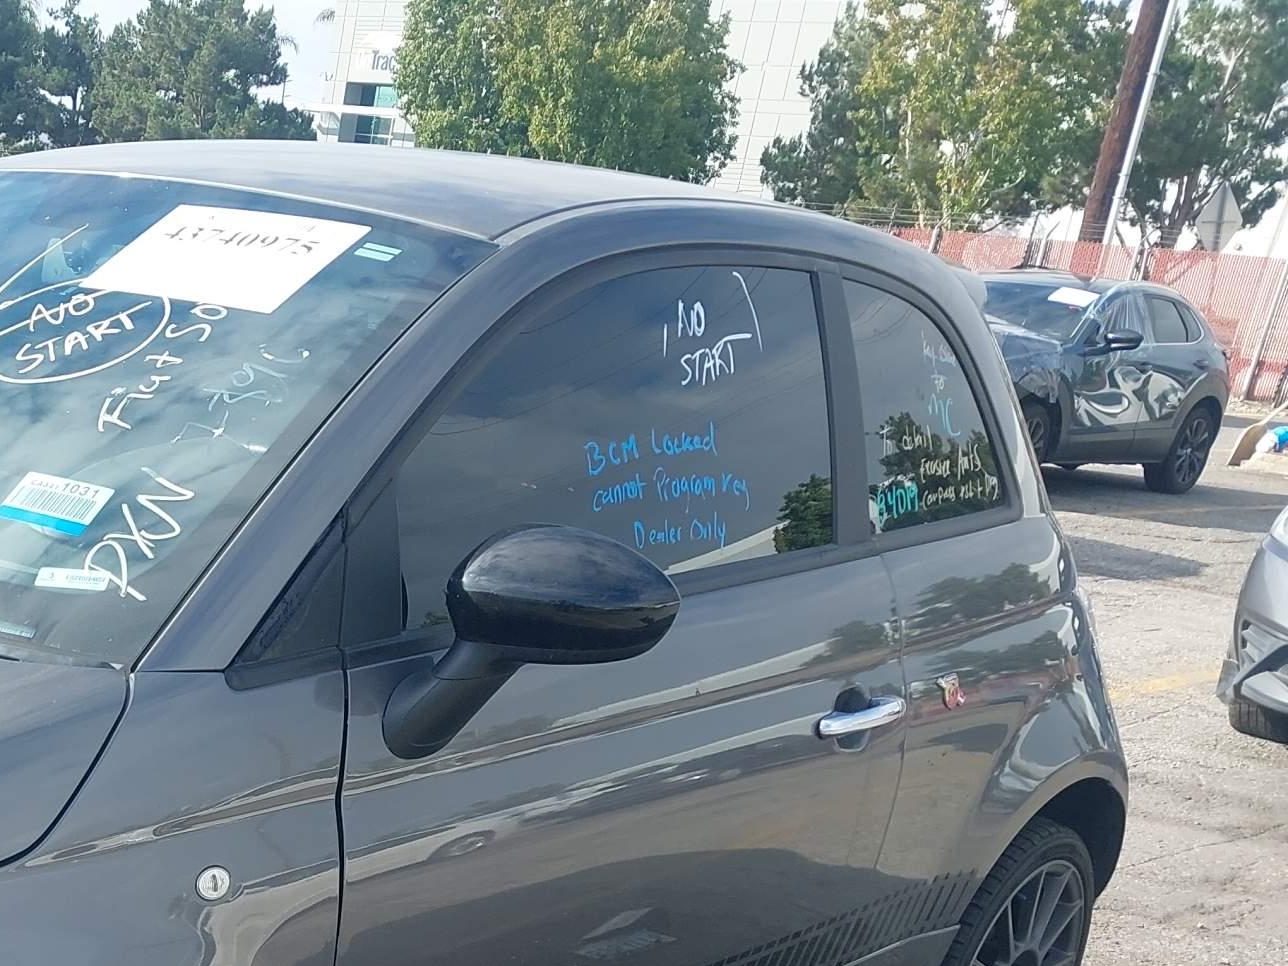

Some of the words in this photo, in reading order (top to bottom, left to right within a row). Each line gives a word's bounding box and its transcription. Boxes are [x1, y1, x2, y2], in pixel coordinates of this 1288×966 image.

[165, 226, 320, 255] 43740975
[29, 293, 95, 332] NO
[678, 299, 705, 338] NO
[15, 301, 153, 374] START
[680, 333, 752, 386] START
[584, 433, 639, 475] BCM
[633, 520, 681, 549] Dealer
[690, 511, 726, 549] Only
